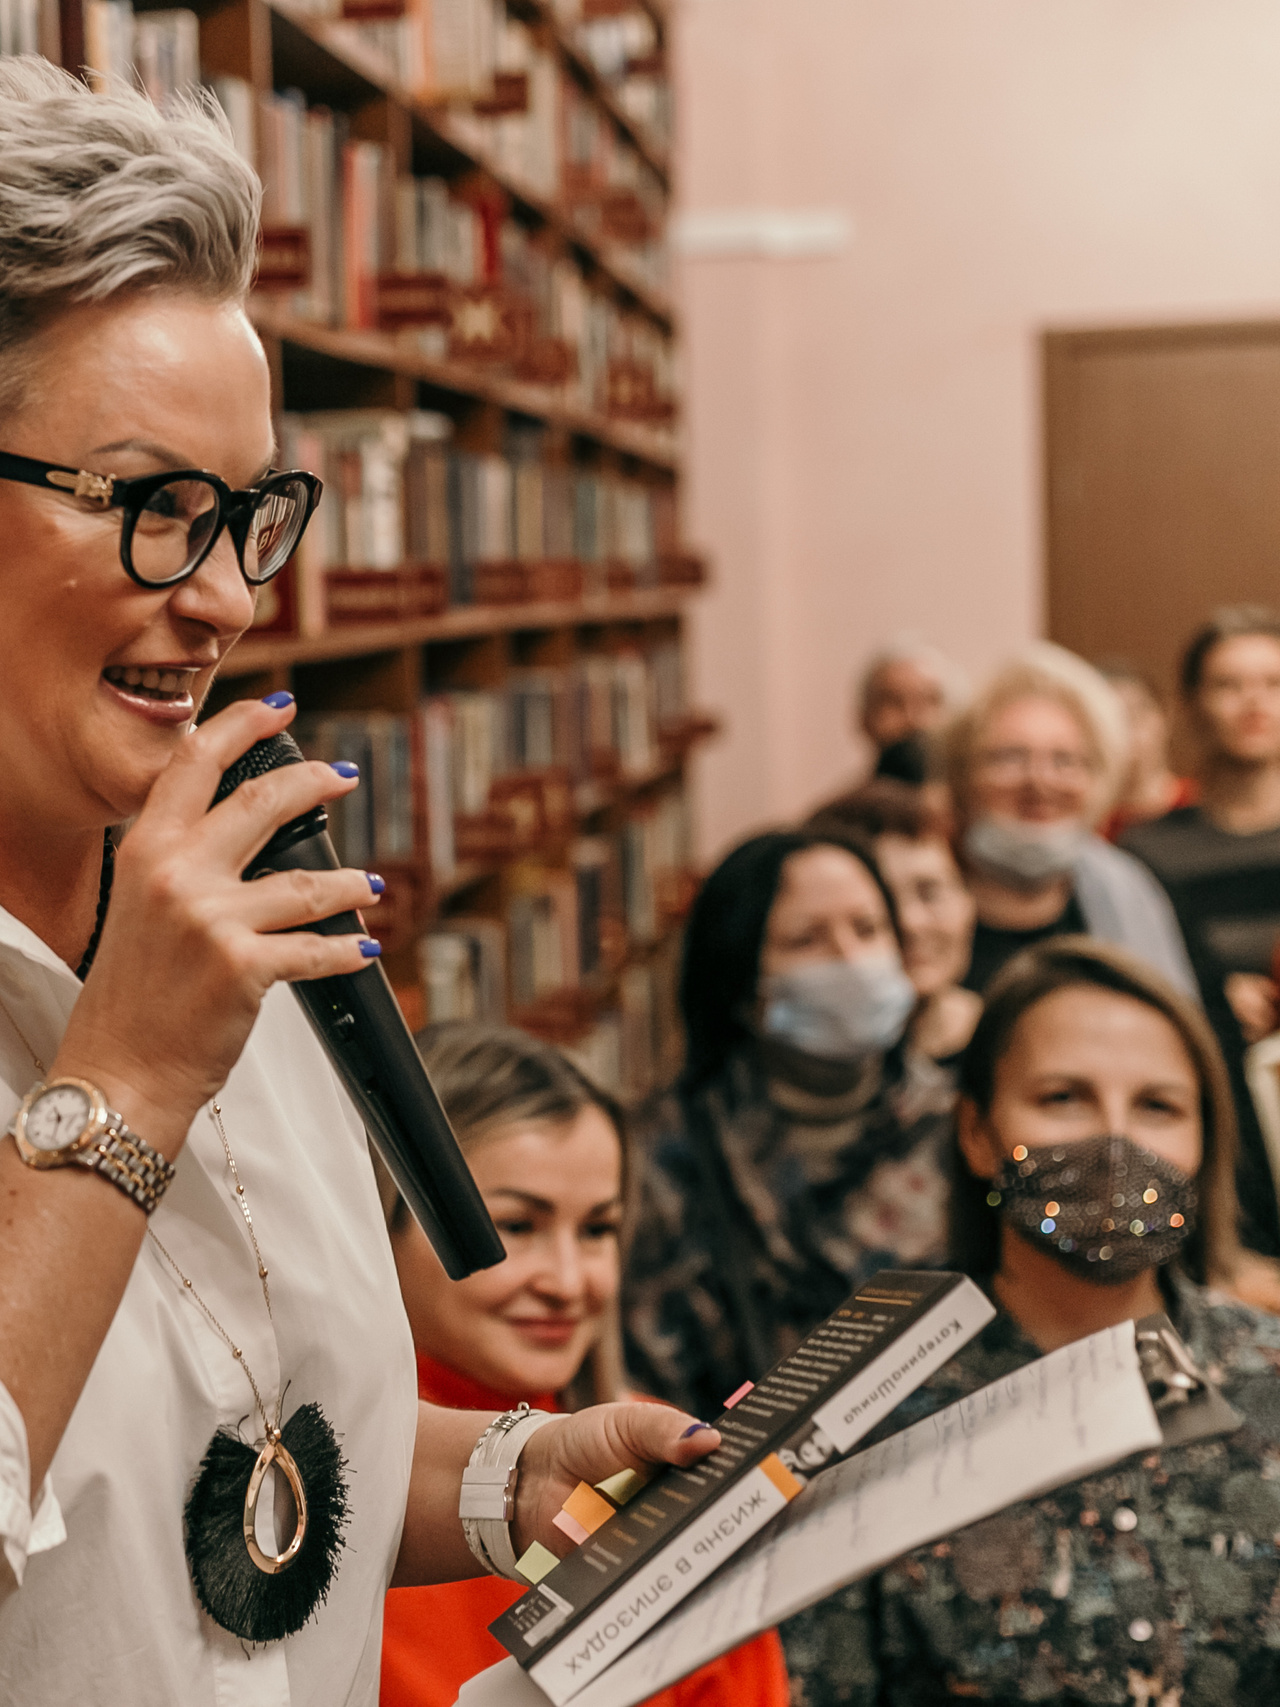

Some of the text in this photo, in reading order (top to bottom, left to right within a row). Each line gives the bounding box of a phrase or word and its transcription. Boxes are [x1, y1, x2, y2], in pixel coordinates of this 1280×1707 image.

[693, 1489, 767, 1556] ЖИЗНЬ
[675, 1557, 692, 1575] В
[565, 1574, 673, 1675] ЭПИЗОДАХ
